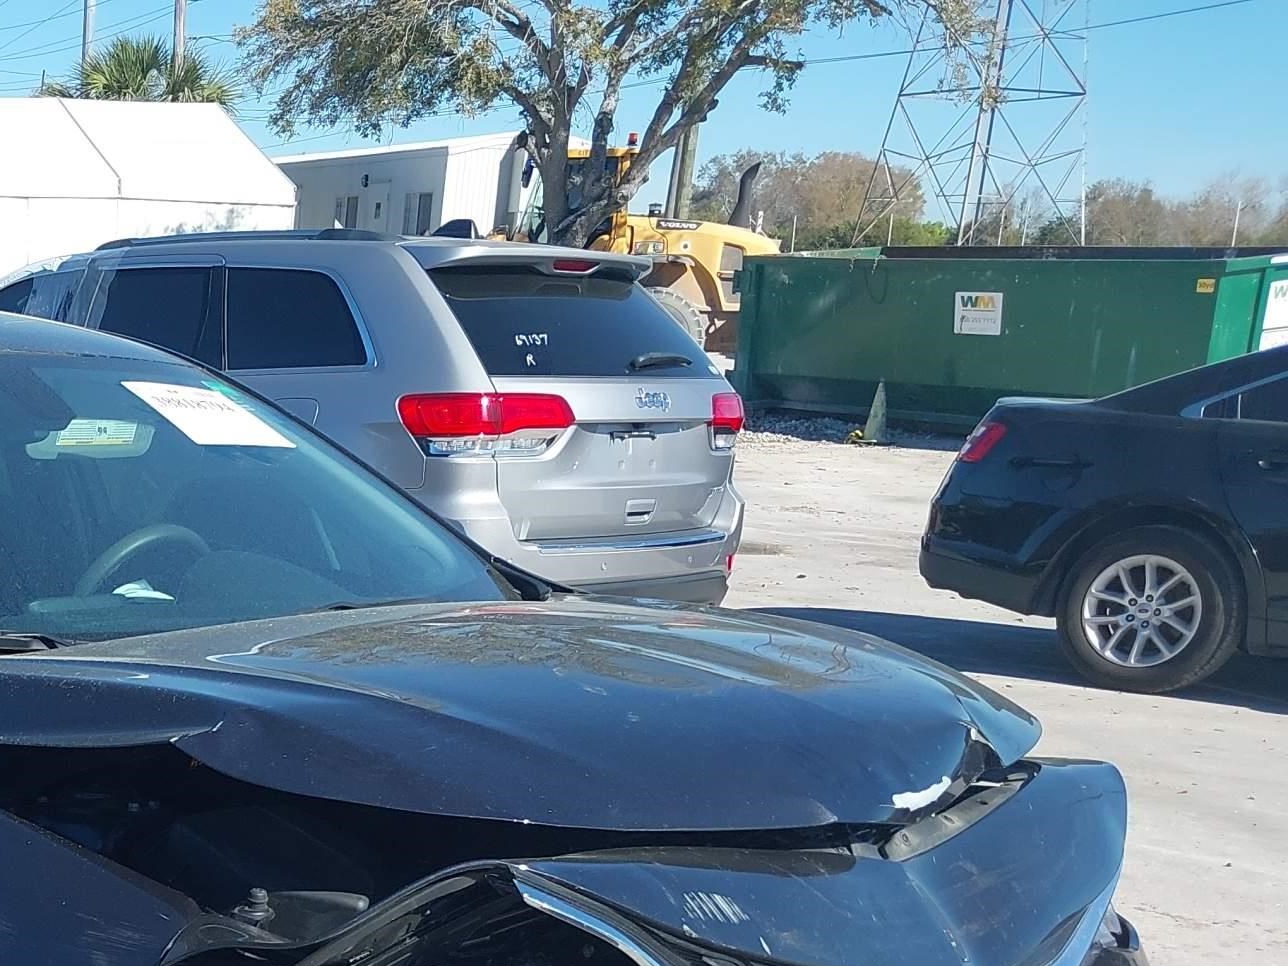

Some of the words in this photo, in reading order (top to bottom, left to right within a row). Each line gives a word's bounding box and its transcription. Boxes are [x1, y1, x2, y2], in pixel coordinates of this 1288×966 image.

[659, 221, 698, 229] VOLVO
[960, 295, 997, 309] WM
[515, 333, 548, 346] 69137
[526, 353, 537, 367] R
[634, 387, 672, 413] Jeep
